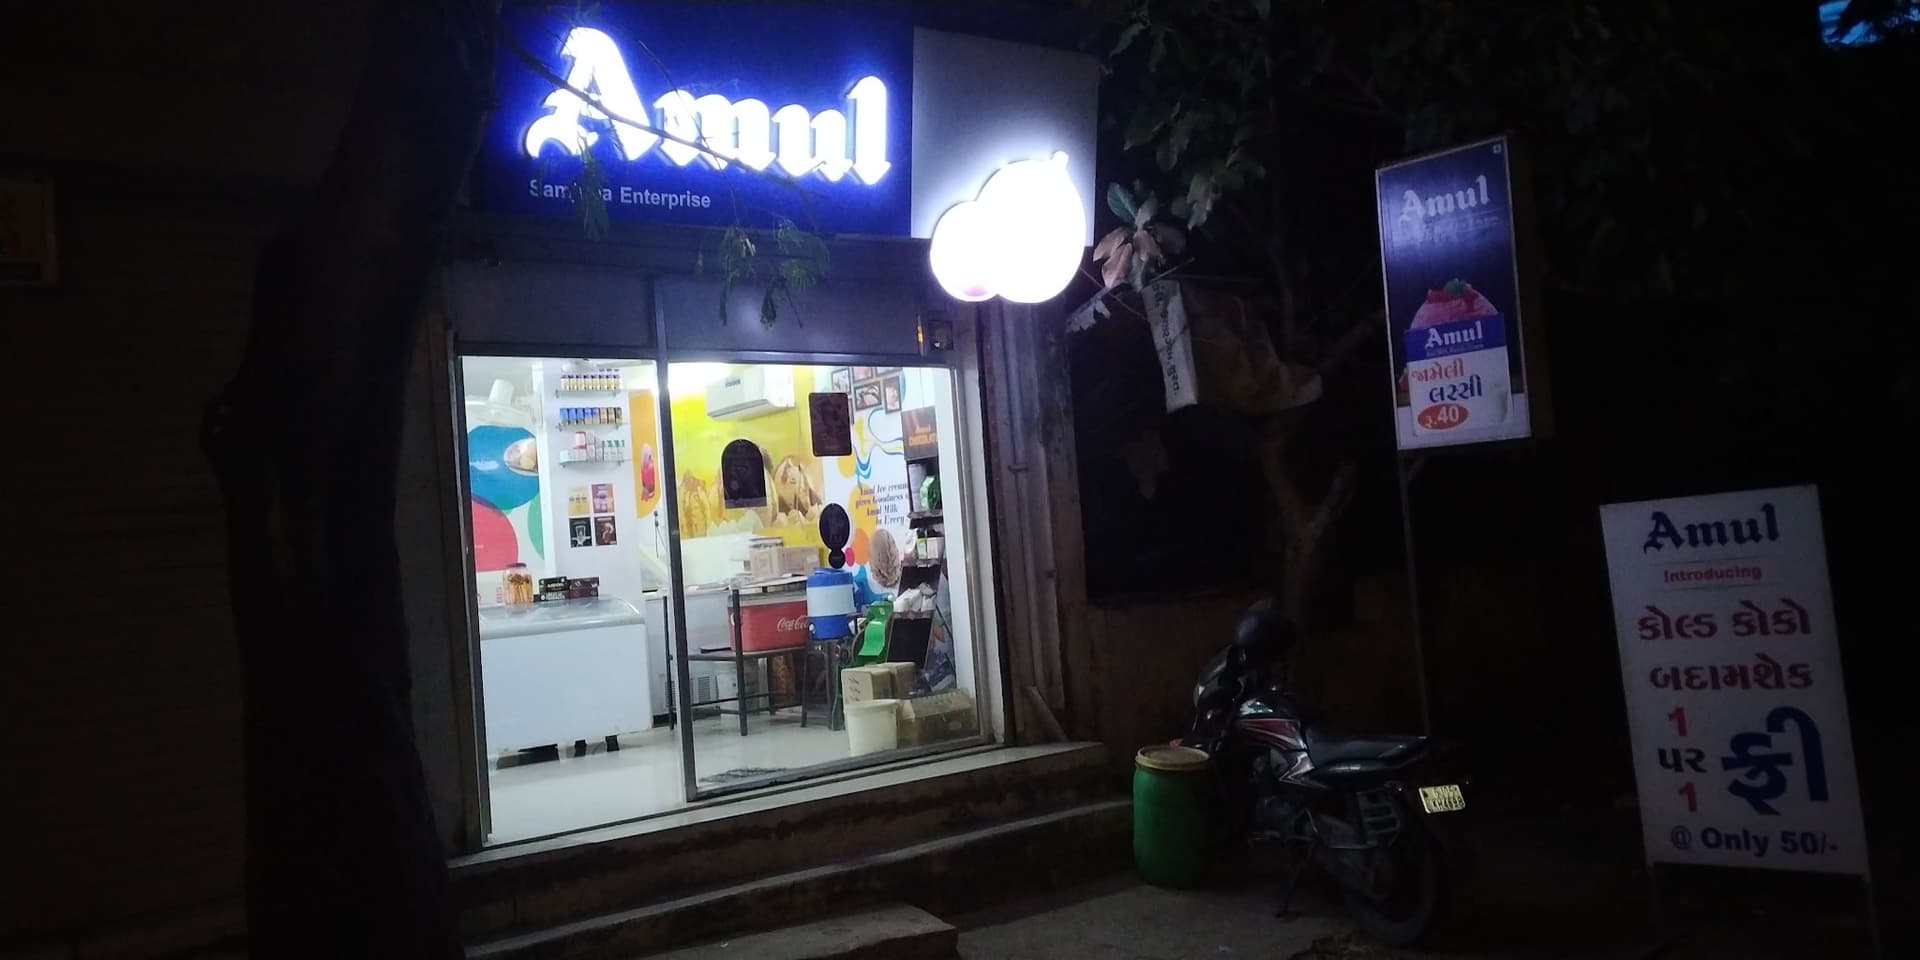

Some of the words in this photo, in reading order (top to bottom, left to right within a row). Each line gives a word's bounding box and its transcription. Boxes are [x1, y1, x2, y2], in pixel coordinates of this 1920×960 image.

[524, 26, 891, 186] Amul
[619, 185, 712, 211] Enterprise
[1399, 174, 1490, 223] Amul
[1425, 320, 1484, 351] Amul
[1643, 502, 1780, 555] Amul
[1663, 564, 1763, 583] Introducing
[1731, 597, 1813, 638] કોકો
[1649, 652, 1814, 692] બદામશેક
[1666, 705, 1689, 738] 1
[1656, 747, 1708, 774] પર
[1678, 781, 1698, 813] 1
[1670, 824, 1693, 850] @
[1701, 826, 1770, 858] Only
[1780, 829, 1839, 856] 50/-
